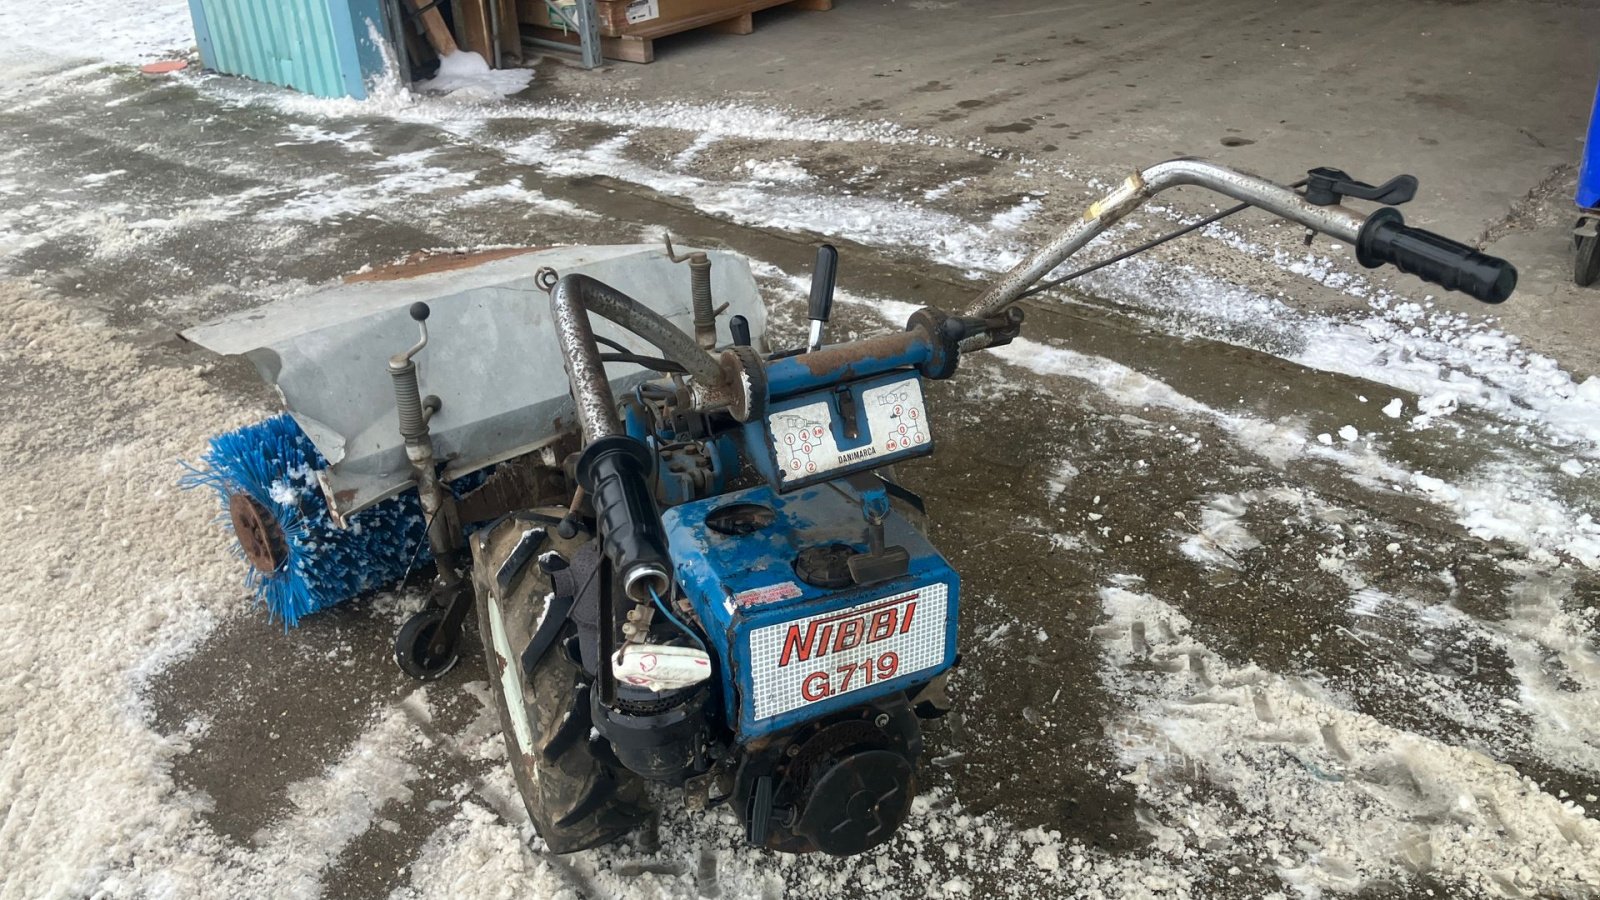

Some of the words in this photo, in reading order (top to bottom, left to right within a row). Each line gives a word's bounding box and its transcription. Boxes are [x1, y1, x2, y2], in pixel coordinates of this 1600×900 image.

[837, 446, 876, 464] DANIMARCA
[778, 596, 918, 667] NIBBI
[801, 651, 899, 702] G.719
